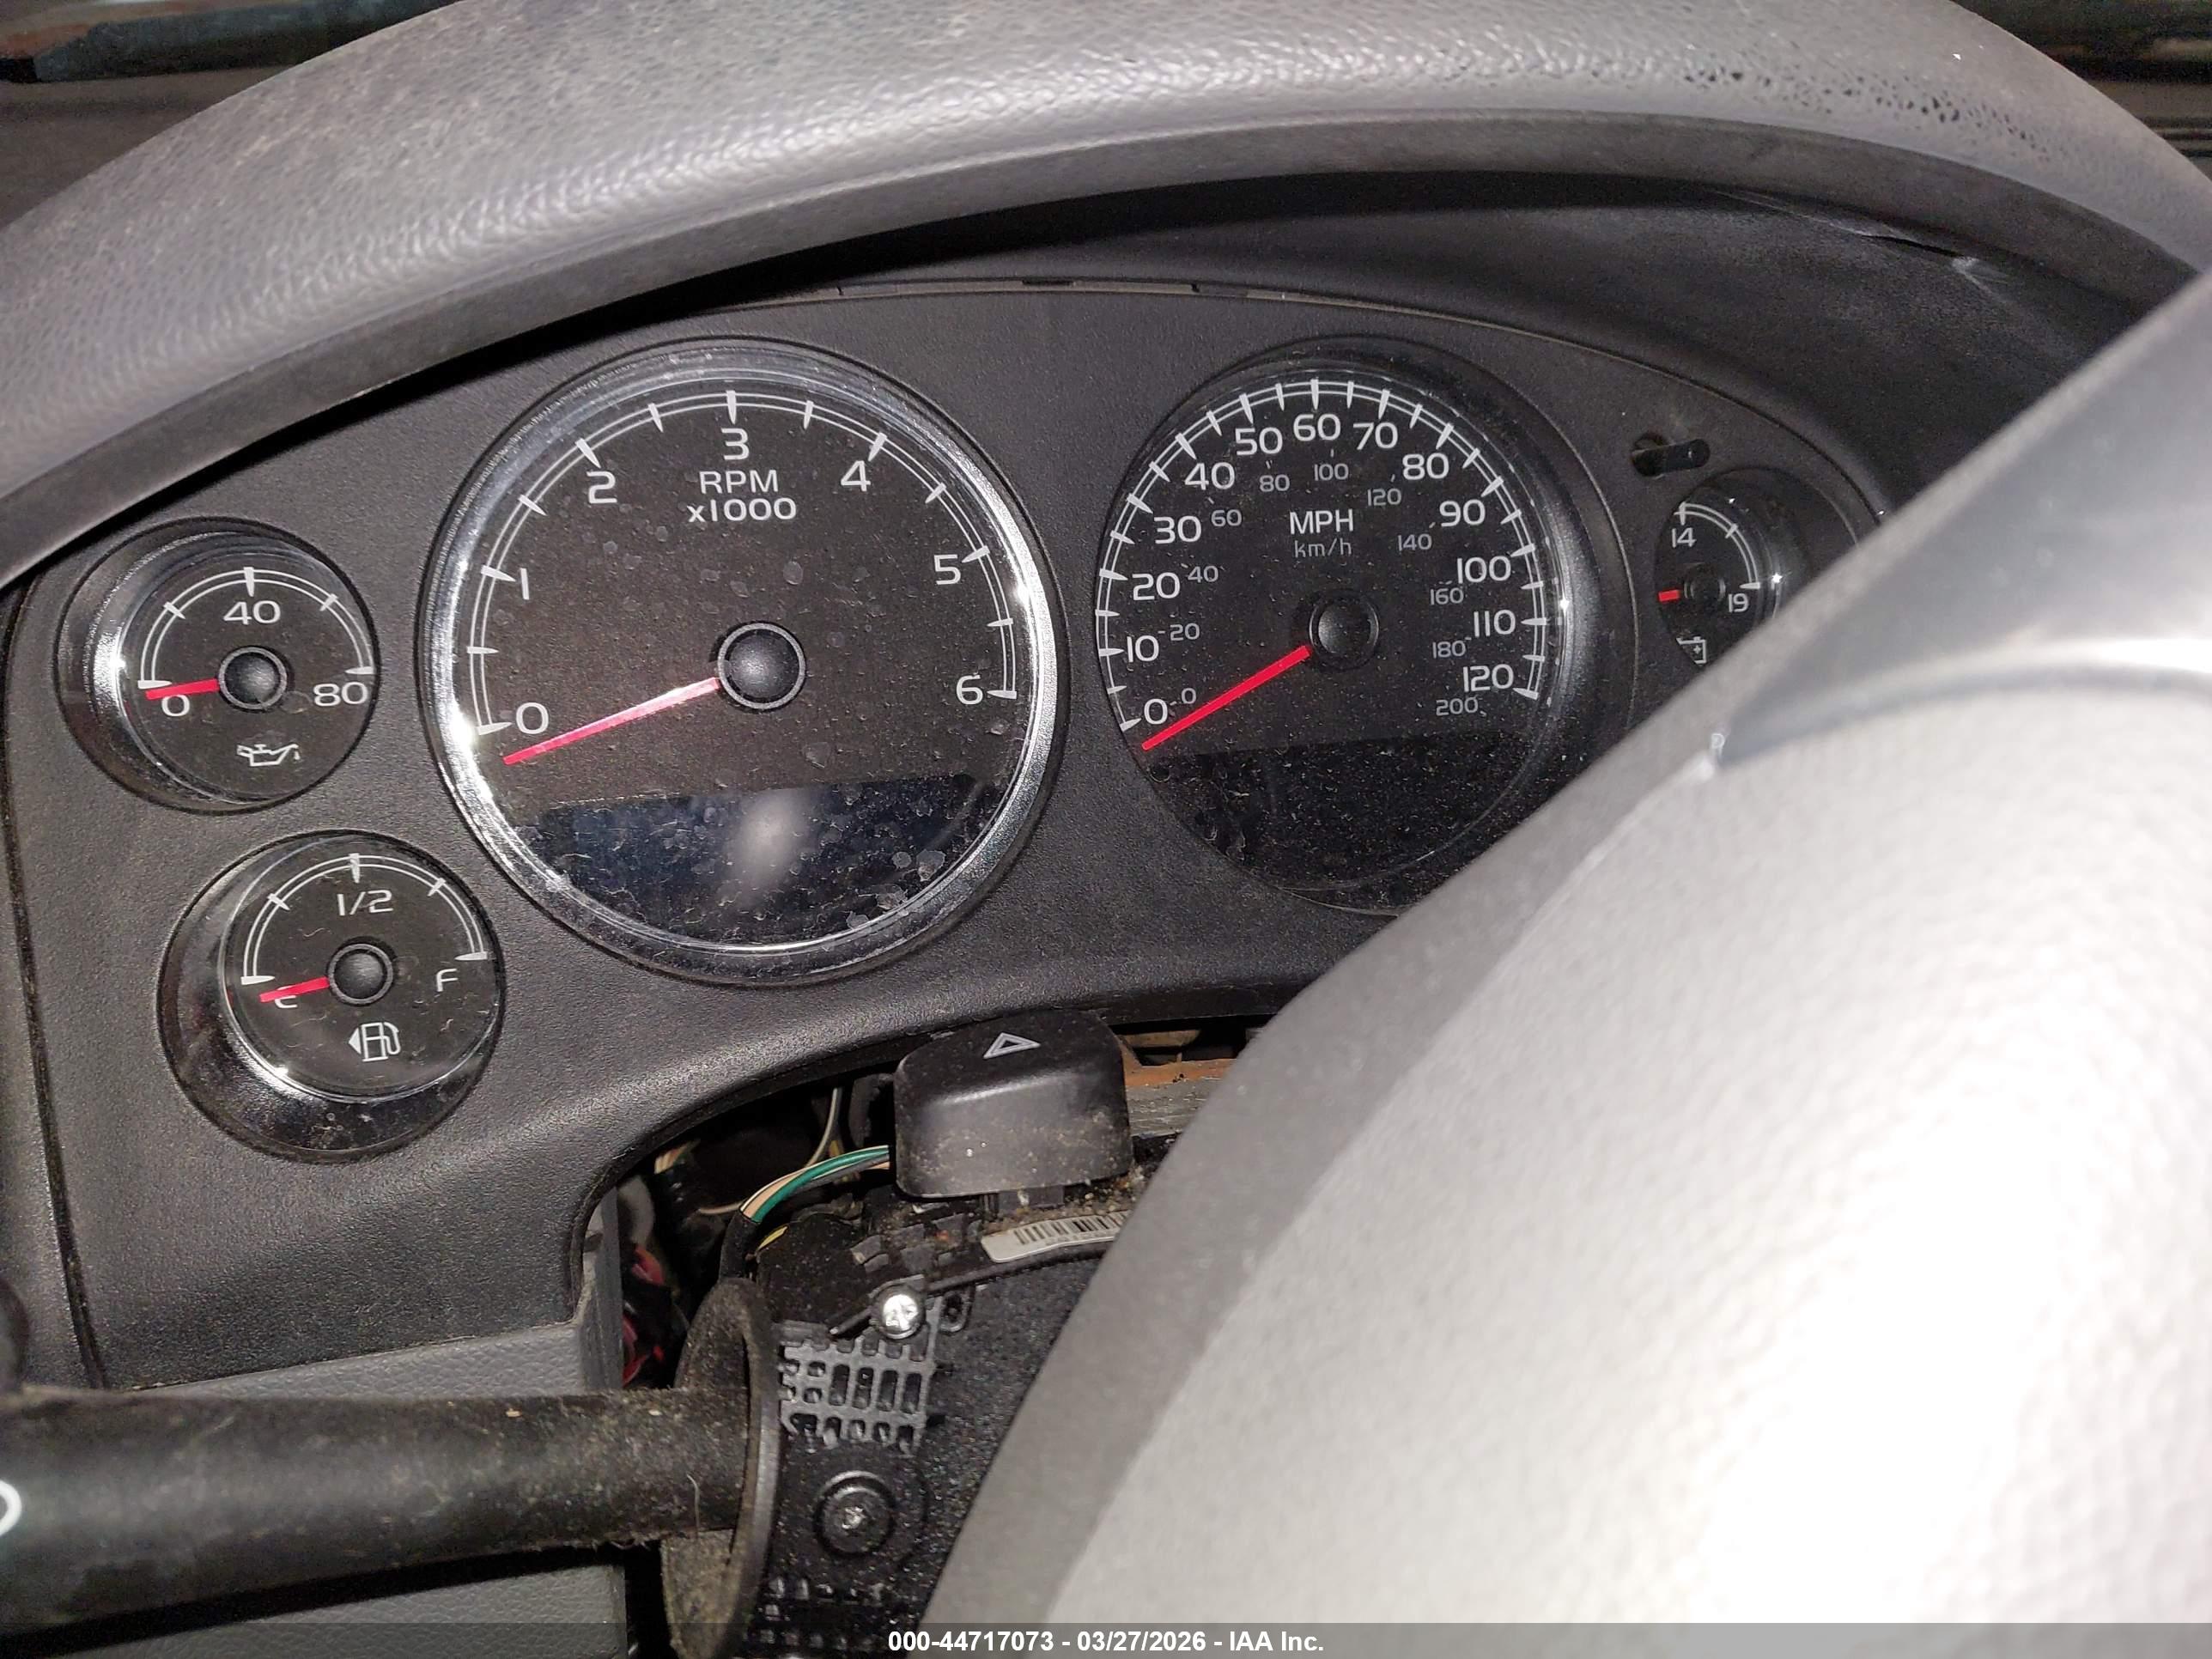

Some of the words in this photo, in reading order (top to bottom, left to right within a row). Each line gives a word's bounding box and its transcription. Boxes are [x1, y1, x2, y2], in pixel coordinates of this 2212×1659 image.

[1293, 414, 1341, 441] 60
[1353, 422, 1399, 451] 70
[722, 428, 750, 460] 3
[1235, 427, 1283, 456] 50
[841, 460, 871, 492] 4
[1184, 462, 1236, 490] 40
[1314, 463, 1349, 482] 100
[1401, 452, 1449, 481] 80
[586, 471, 617, 504] 2
[699, 470, 779, 495] RPM
[1259, 474, 1290, 492] 80
[687, 496, 797, 523] x1000
[1367, 488, 1402, 507] 120
[1211, 509, 1243, 527] 60
[1289, 508, 1354, 535] MPH
[1439, 499, 1486, 527] 90
[1154, 515, 1202, 544] 30
[1397, 533, 1432, 552] 140
[1671, 527, 1697, 548] 14
[1294, 538, 1352, 558] km/h
[933, 554, 962, 585] 5
[1188, 566, 1218, 584] 40
[1456, 556, 1511, 584] 100
[520, 568, 529, 600] 1
[1132, 572, 1181, 601] 20
[1430, 587, 1464, 605] 160
[223, 600, 281, 624] 40
[1728, 593, 1749, 612] 19
[1170, 623, 1200, 641] 20
[1474, 610, 1516, 637] 110
[1127, 635, 1159, 663] 10
[1432, 640, 1466, 659] 180
[956, 674, 983, 705] 6
[1462, 664, 1514, 693] 120
[161, 694, 191, 717] 0
[313, 682, 368, 707] 80
[1182, 688, 1196, 705] 0
[1436, 697, 1478, 716] 200
[516, 702, 550, 734] 0
[1144, 697, 1168, 726] 0
[337, 890, 394, 916] 1/2
[436, 968, 459, 992] F
